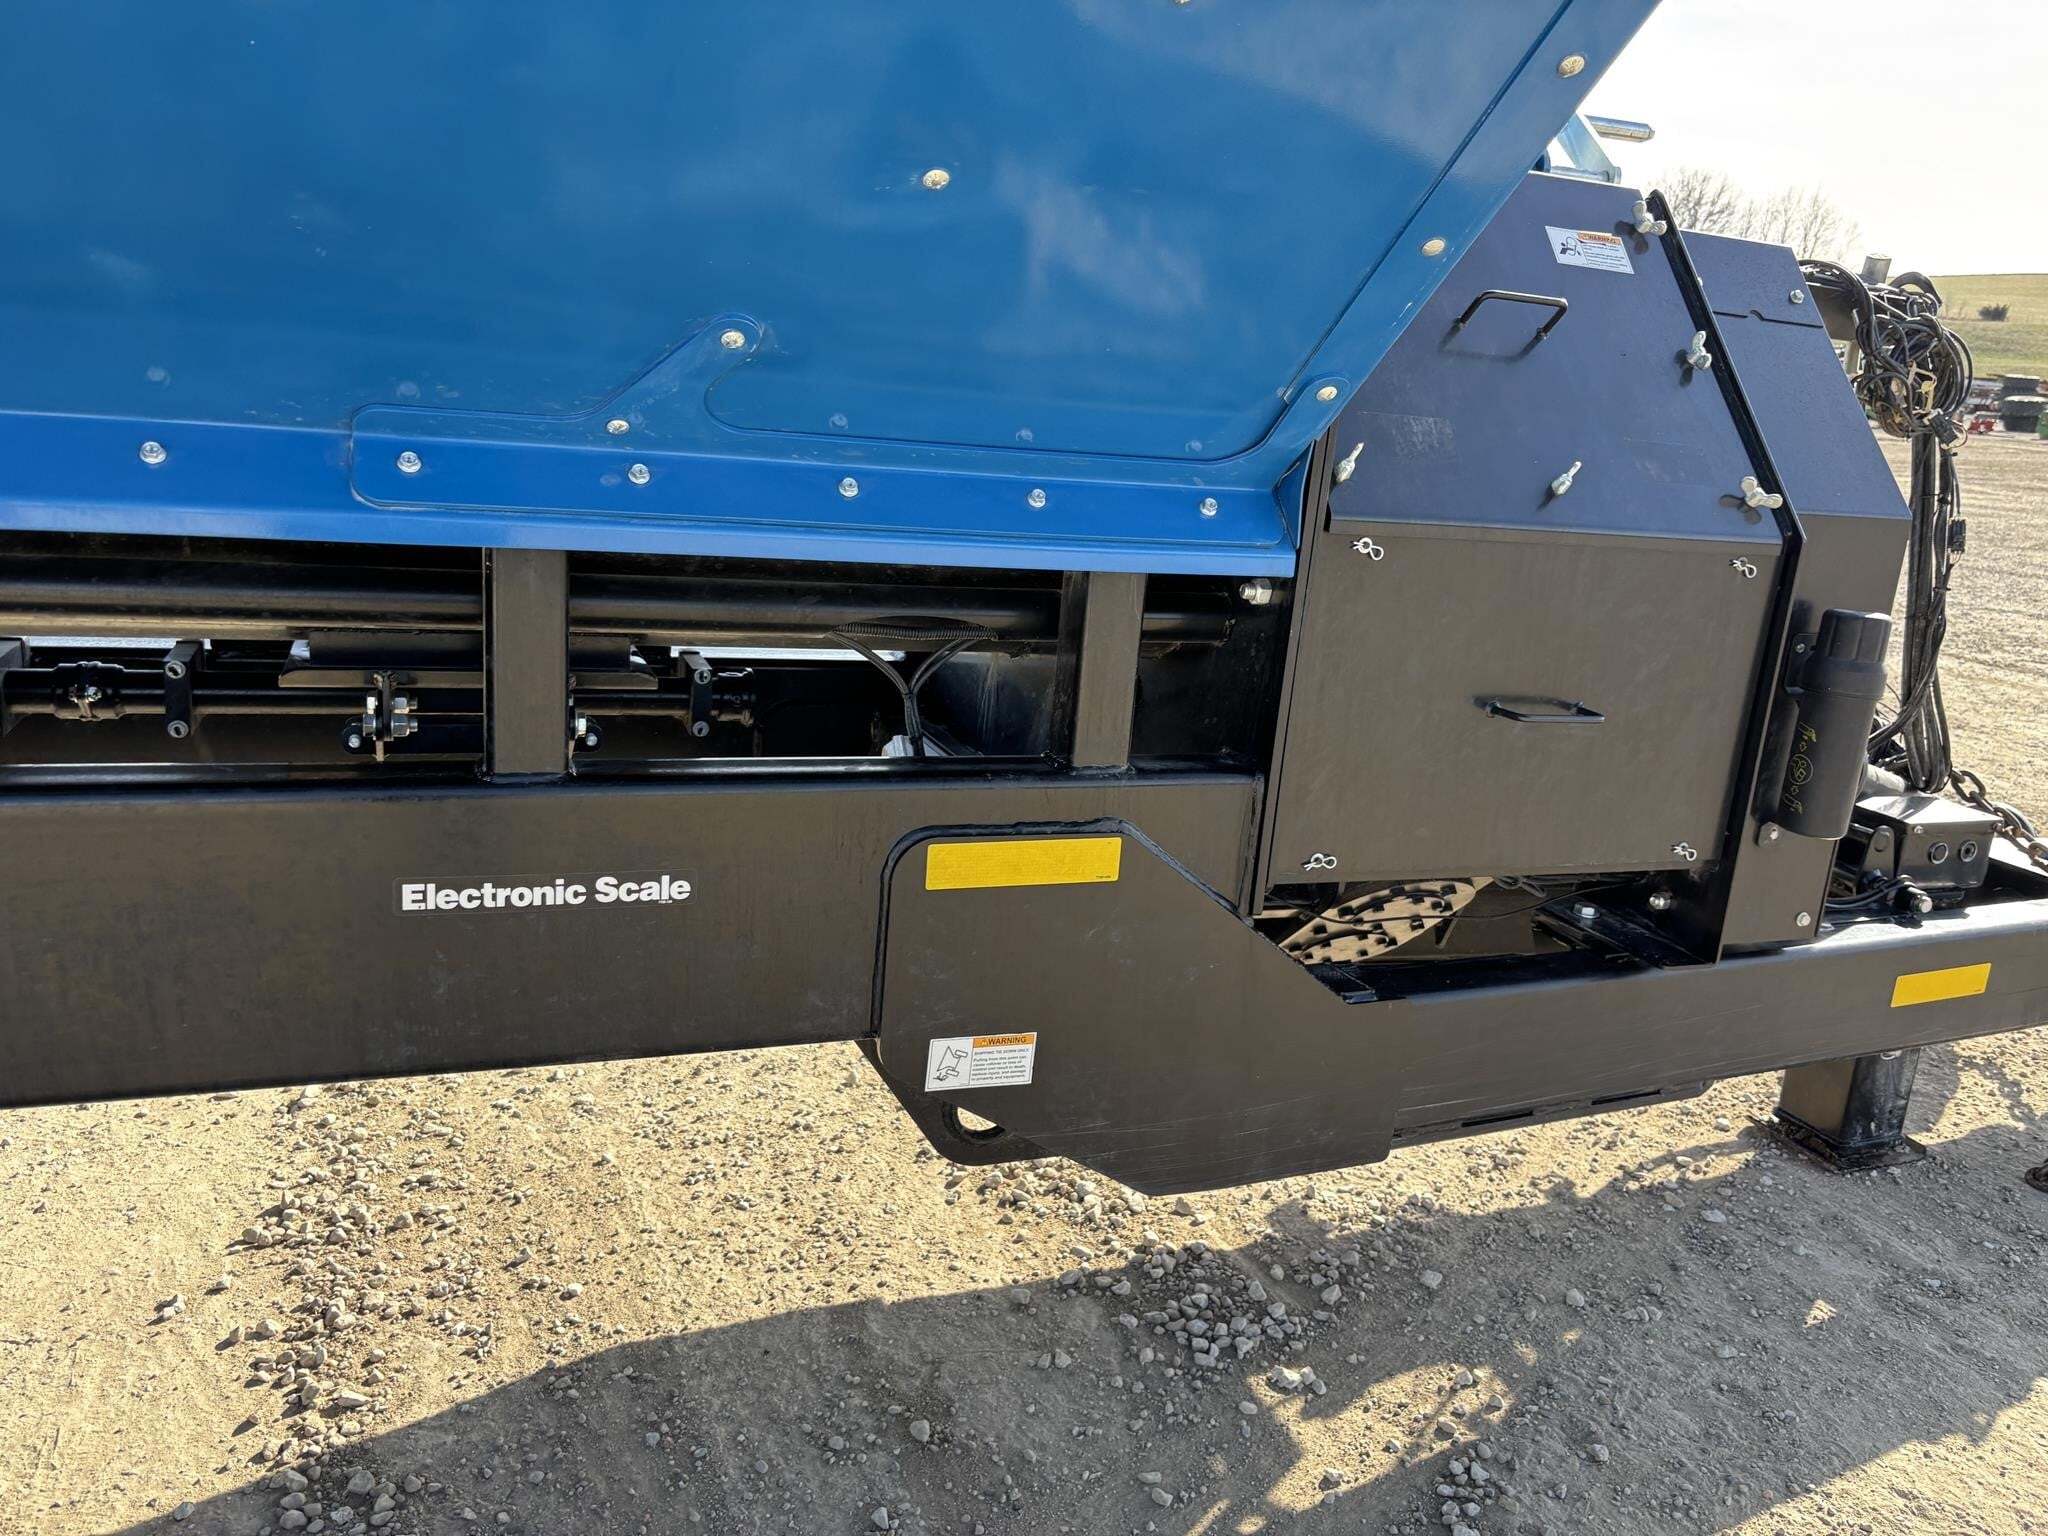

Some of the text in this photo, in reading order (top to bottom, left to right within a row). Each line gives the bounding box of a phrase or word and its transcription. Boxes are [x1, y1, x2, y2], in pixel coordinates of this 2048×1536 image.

[402, 875, 692, 911] Electronic Scale
[988, 1036, 1027, 1046] WARNING
